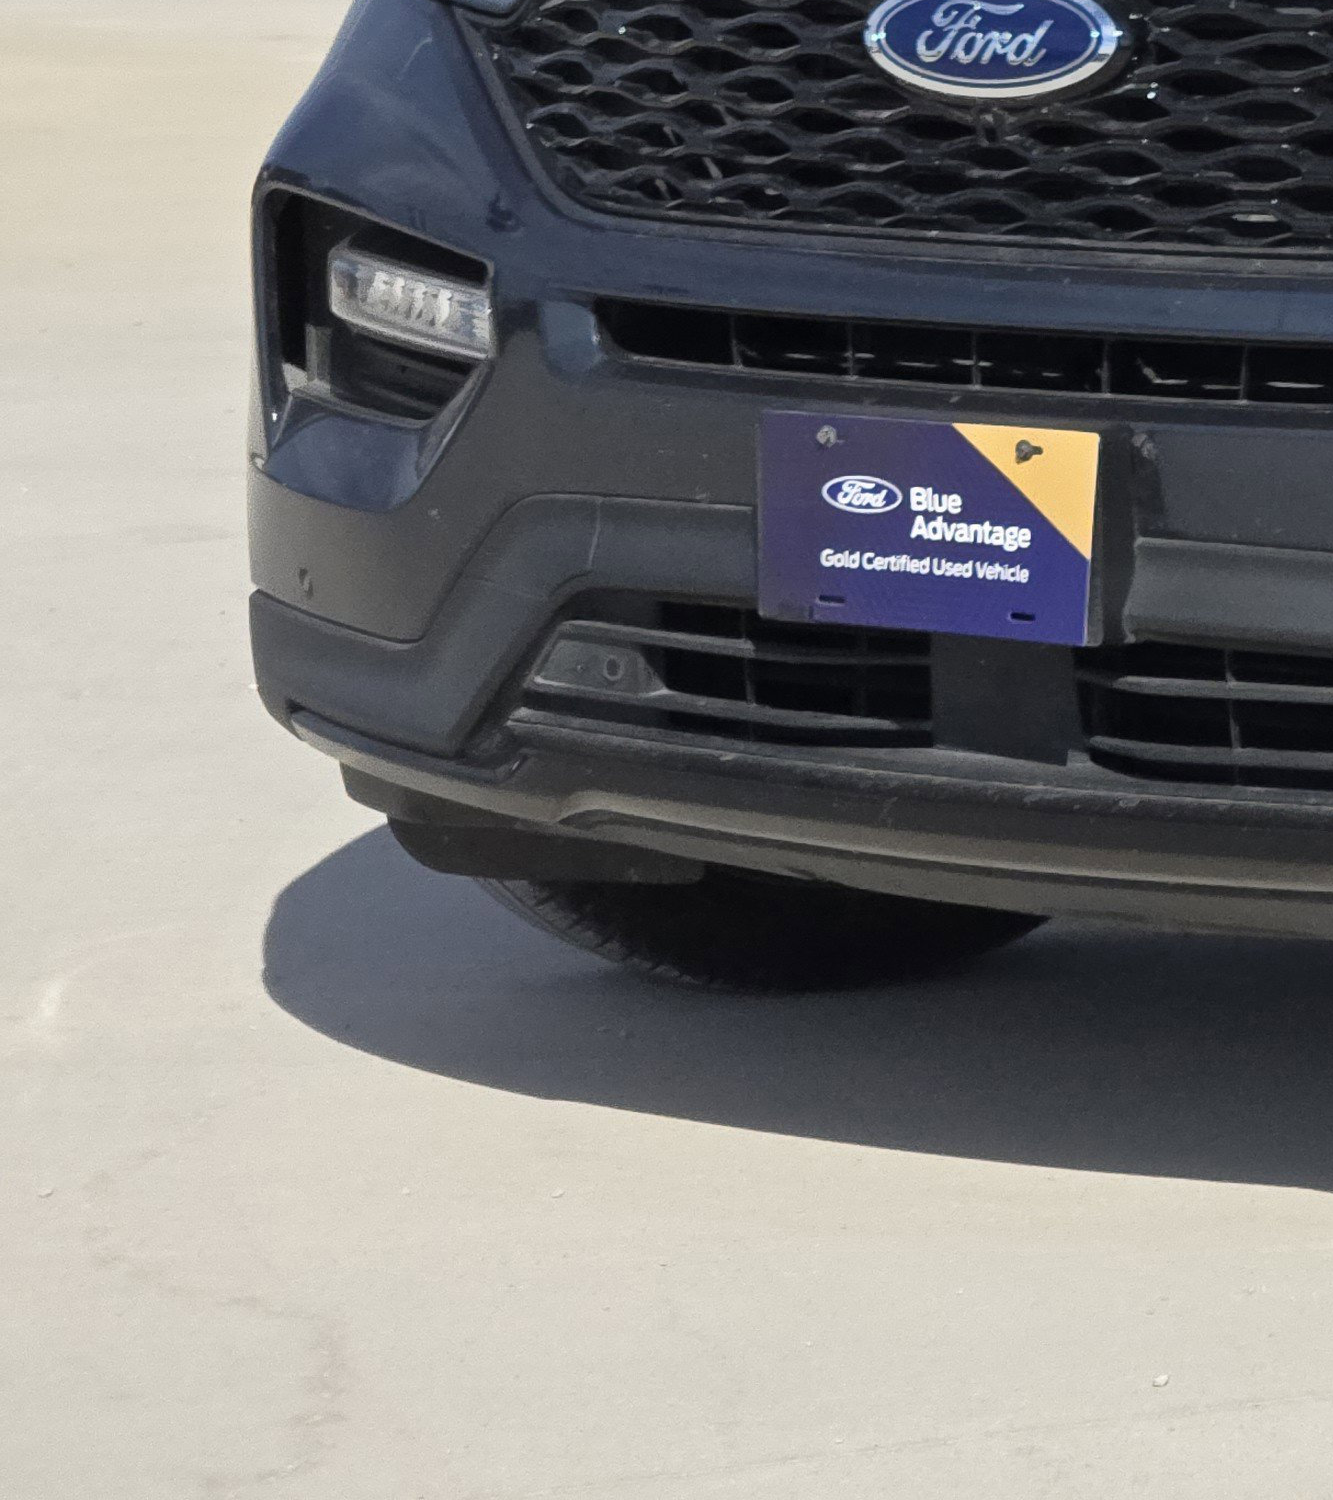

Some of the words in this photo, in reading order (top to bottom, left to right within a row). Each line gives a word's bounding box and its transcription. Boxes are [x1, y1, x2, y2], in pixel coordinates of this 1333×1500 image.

[836, 479, 888, 508] Ford
[909, 485, 963, 515] Blue
[909, 514, 1031, 551] Advantage
[819, 548, 861, 569] Gold
[861, 551, 931, 575] Certified
[932, 557, 974, 579] Used
[974, 560, 1030, 584] Vehicle
